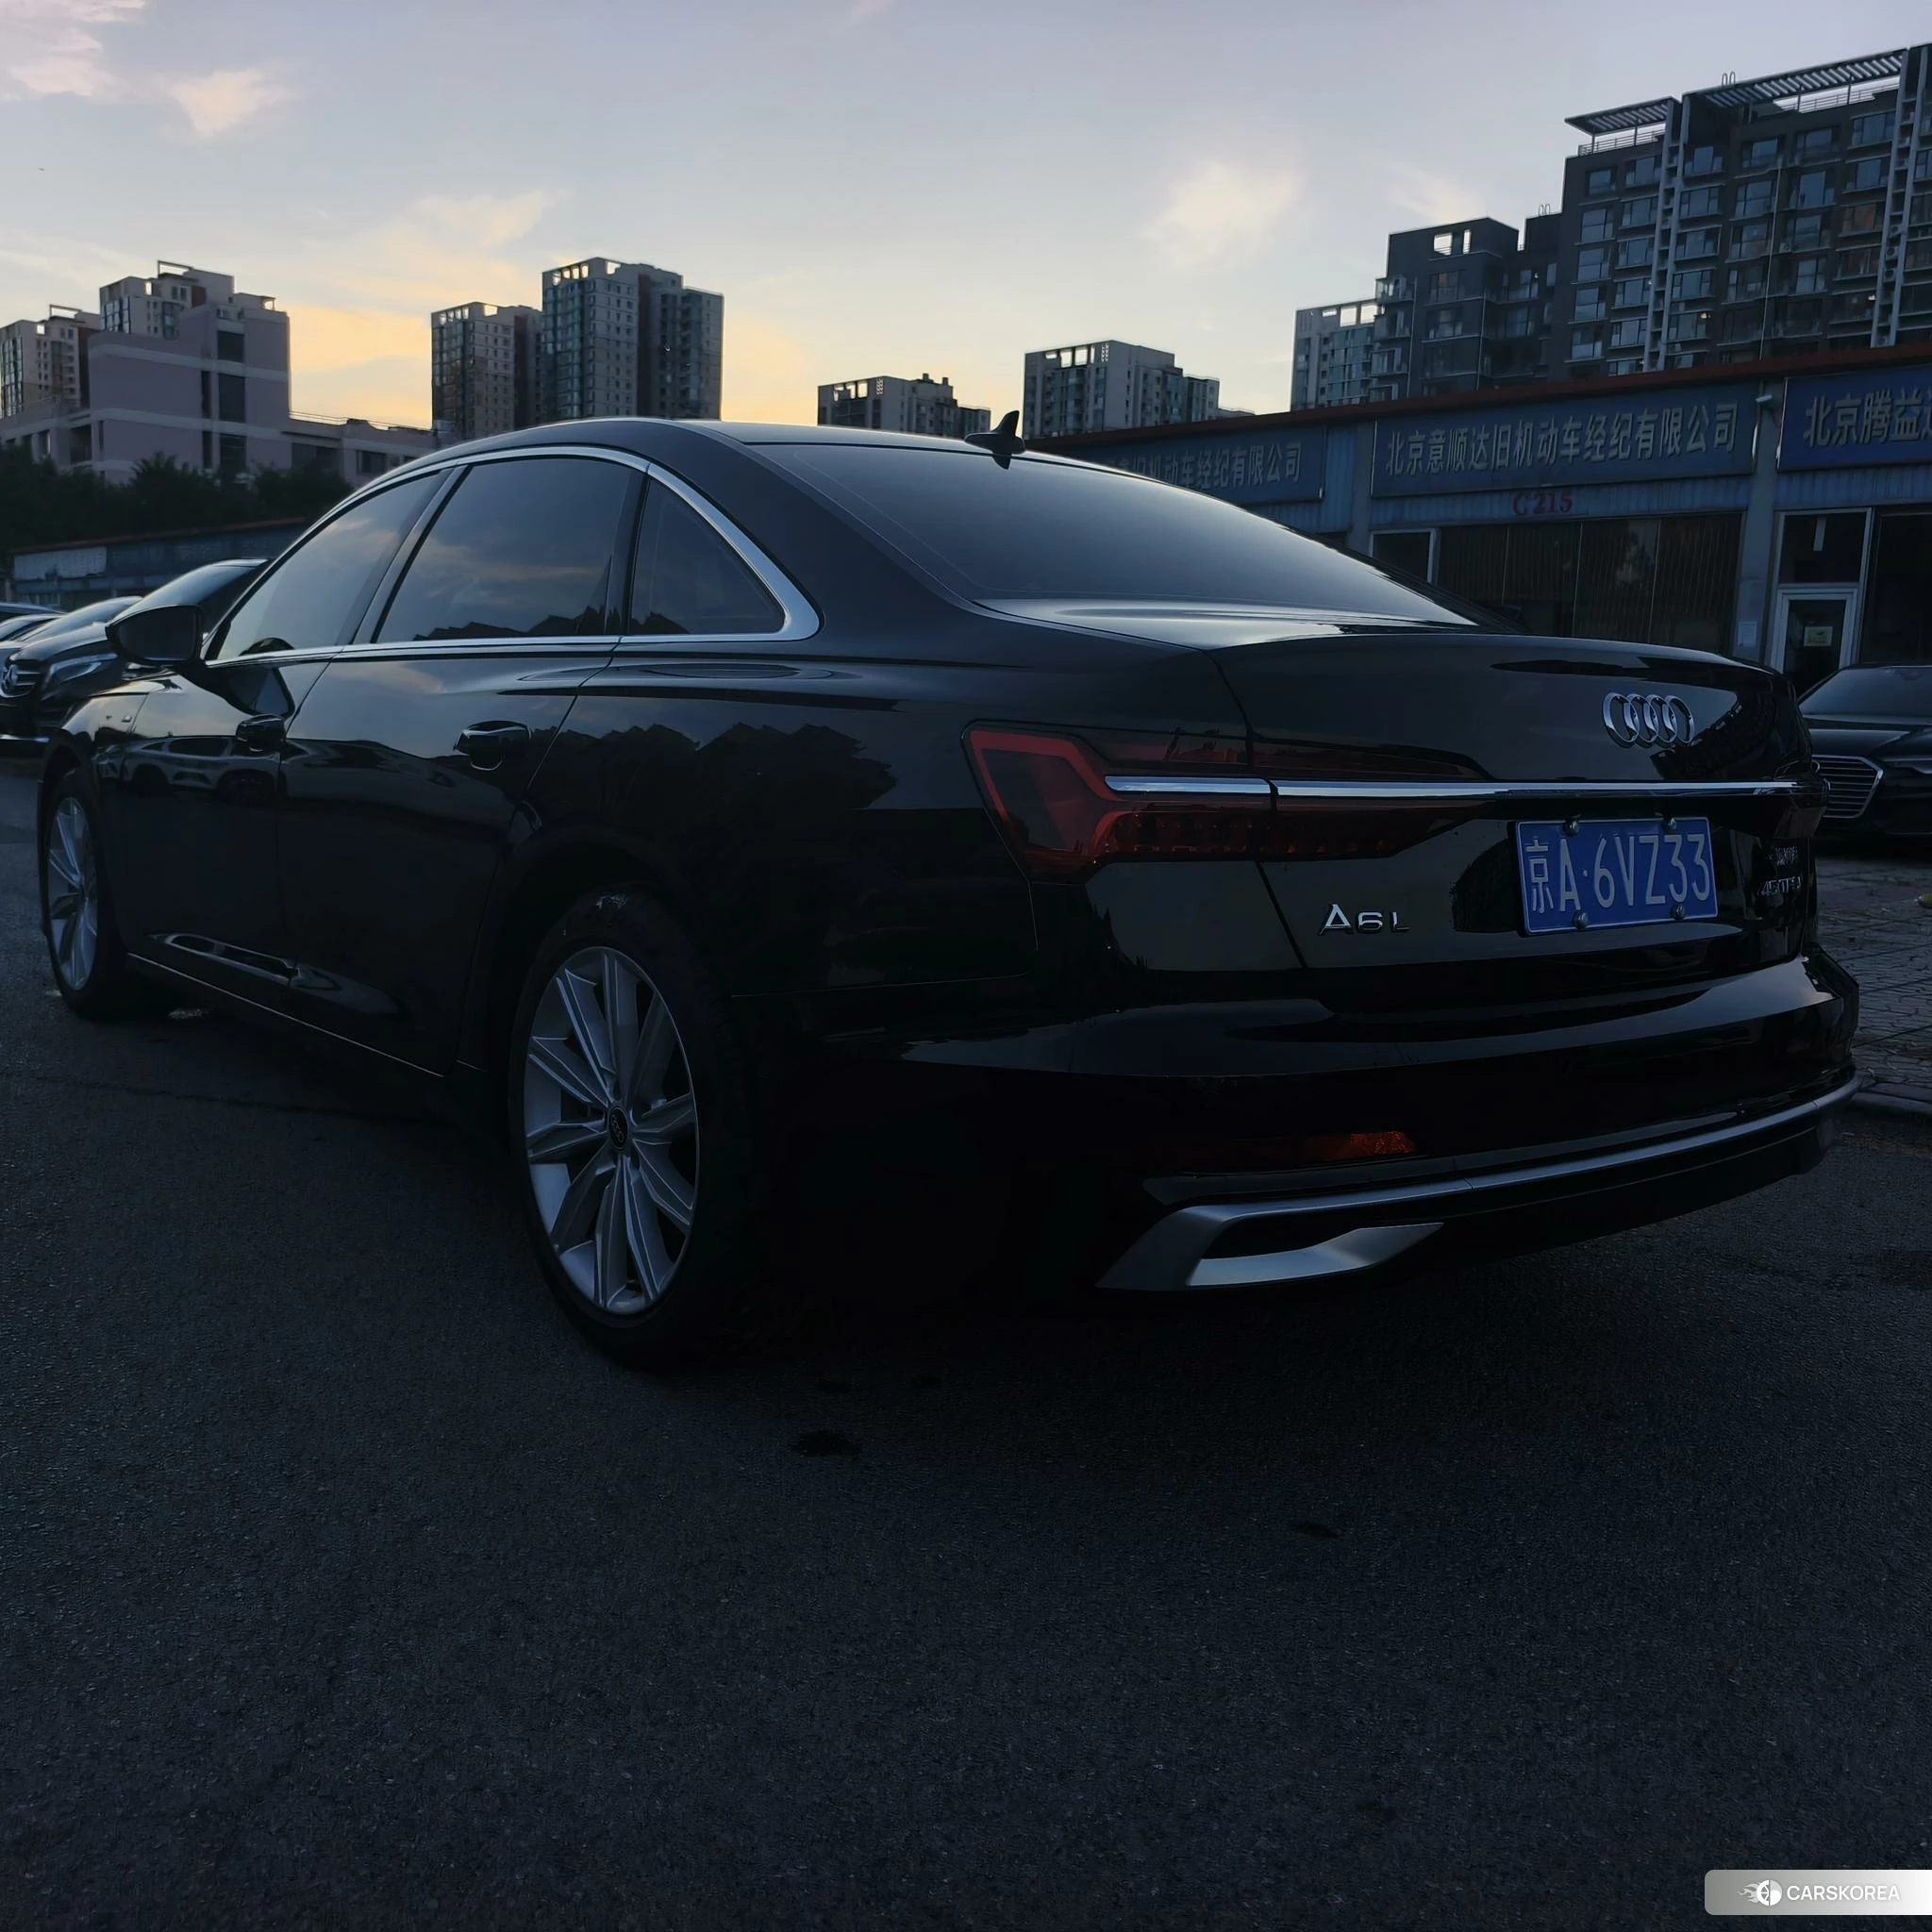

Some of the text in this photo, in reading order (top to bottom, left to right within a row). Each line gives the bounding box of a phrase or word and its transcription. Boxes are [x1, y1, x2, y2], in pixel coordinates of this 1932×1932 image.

[1385, 402, 1739, 476] 北京意顺达旧机动车经纪有限公司
[1318, 903, 1411, 936] A6L
